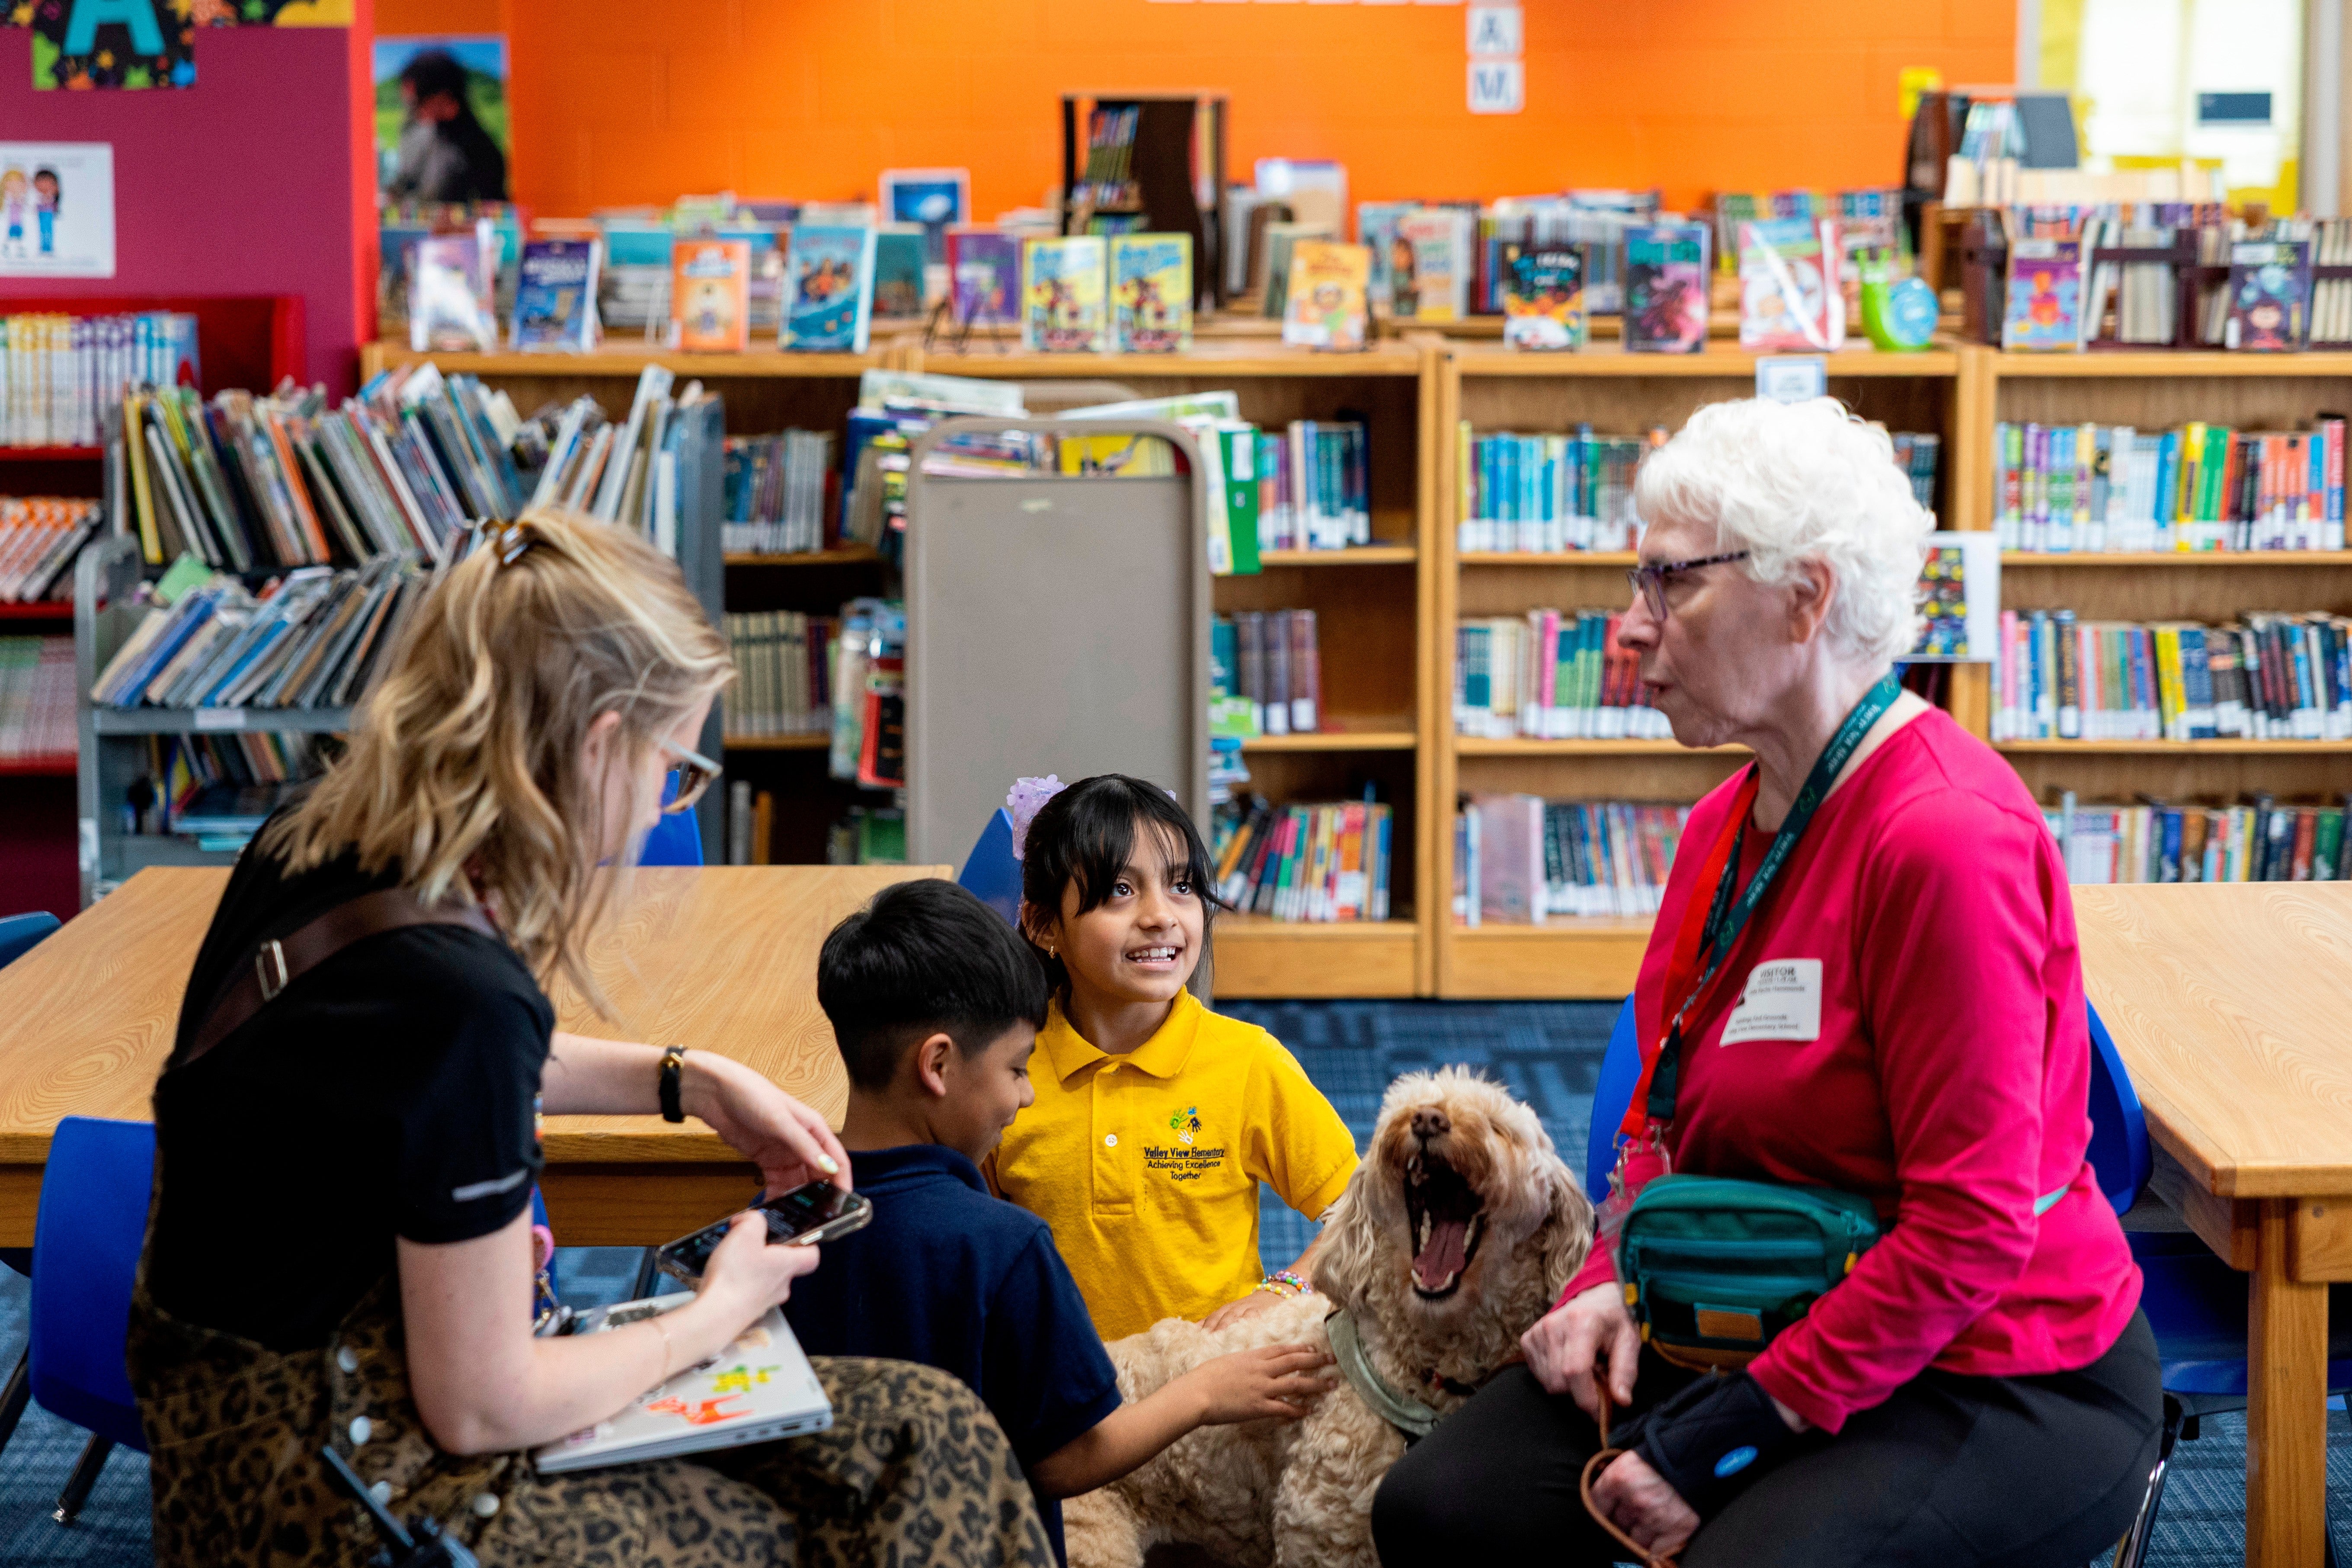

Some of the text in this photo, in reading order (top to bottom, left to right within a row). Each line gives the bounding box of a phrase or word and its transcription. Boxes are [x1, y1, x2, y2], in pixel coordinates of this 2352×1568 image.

[1760, 967, 1795, 978] VISITOR
[1144, 1146, 1225, 1159] Valley View Elementary
[1147, 1159, 1221, 1171] Achieving Excellence
[1170, 1170, 1201, 1181] Together
